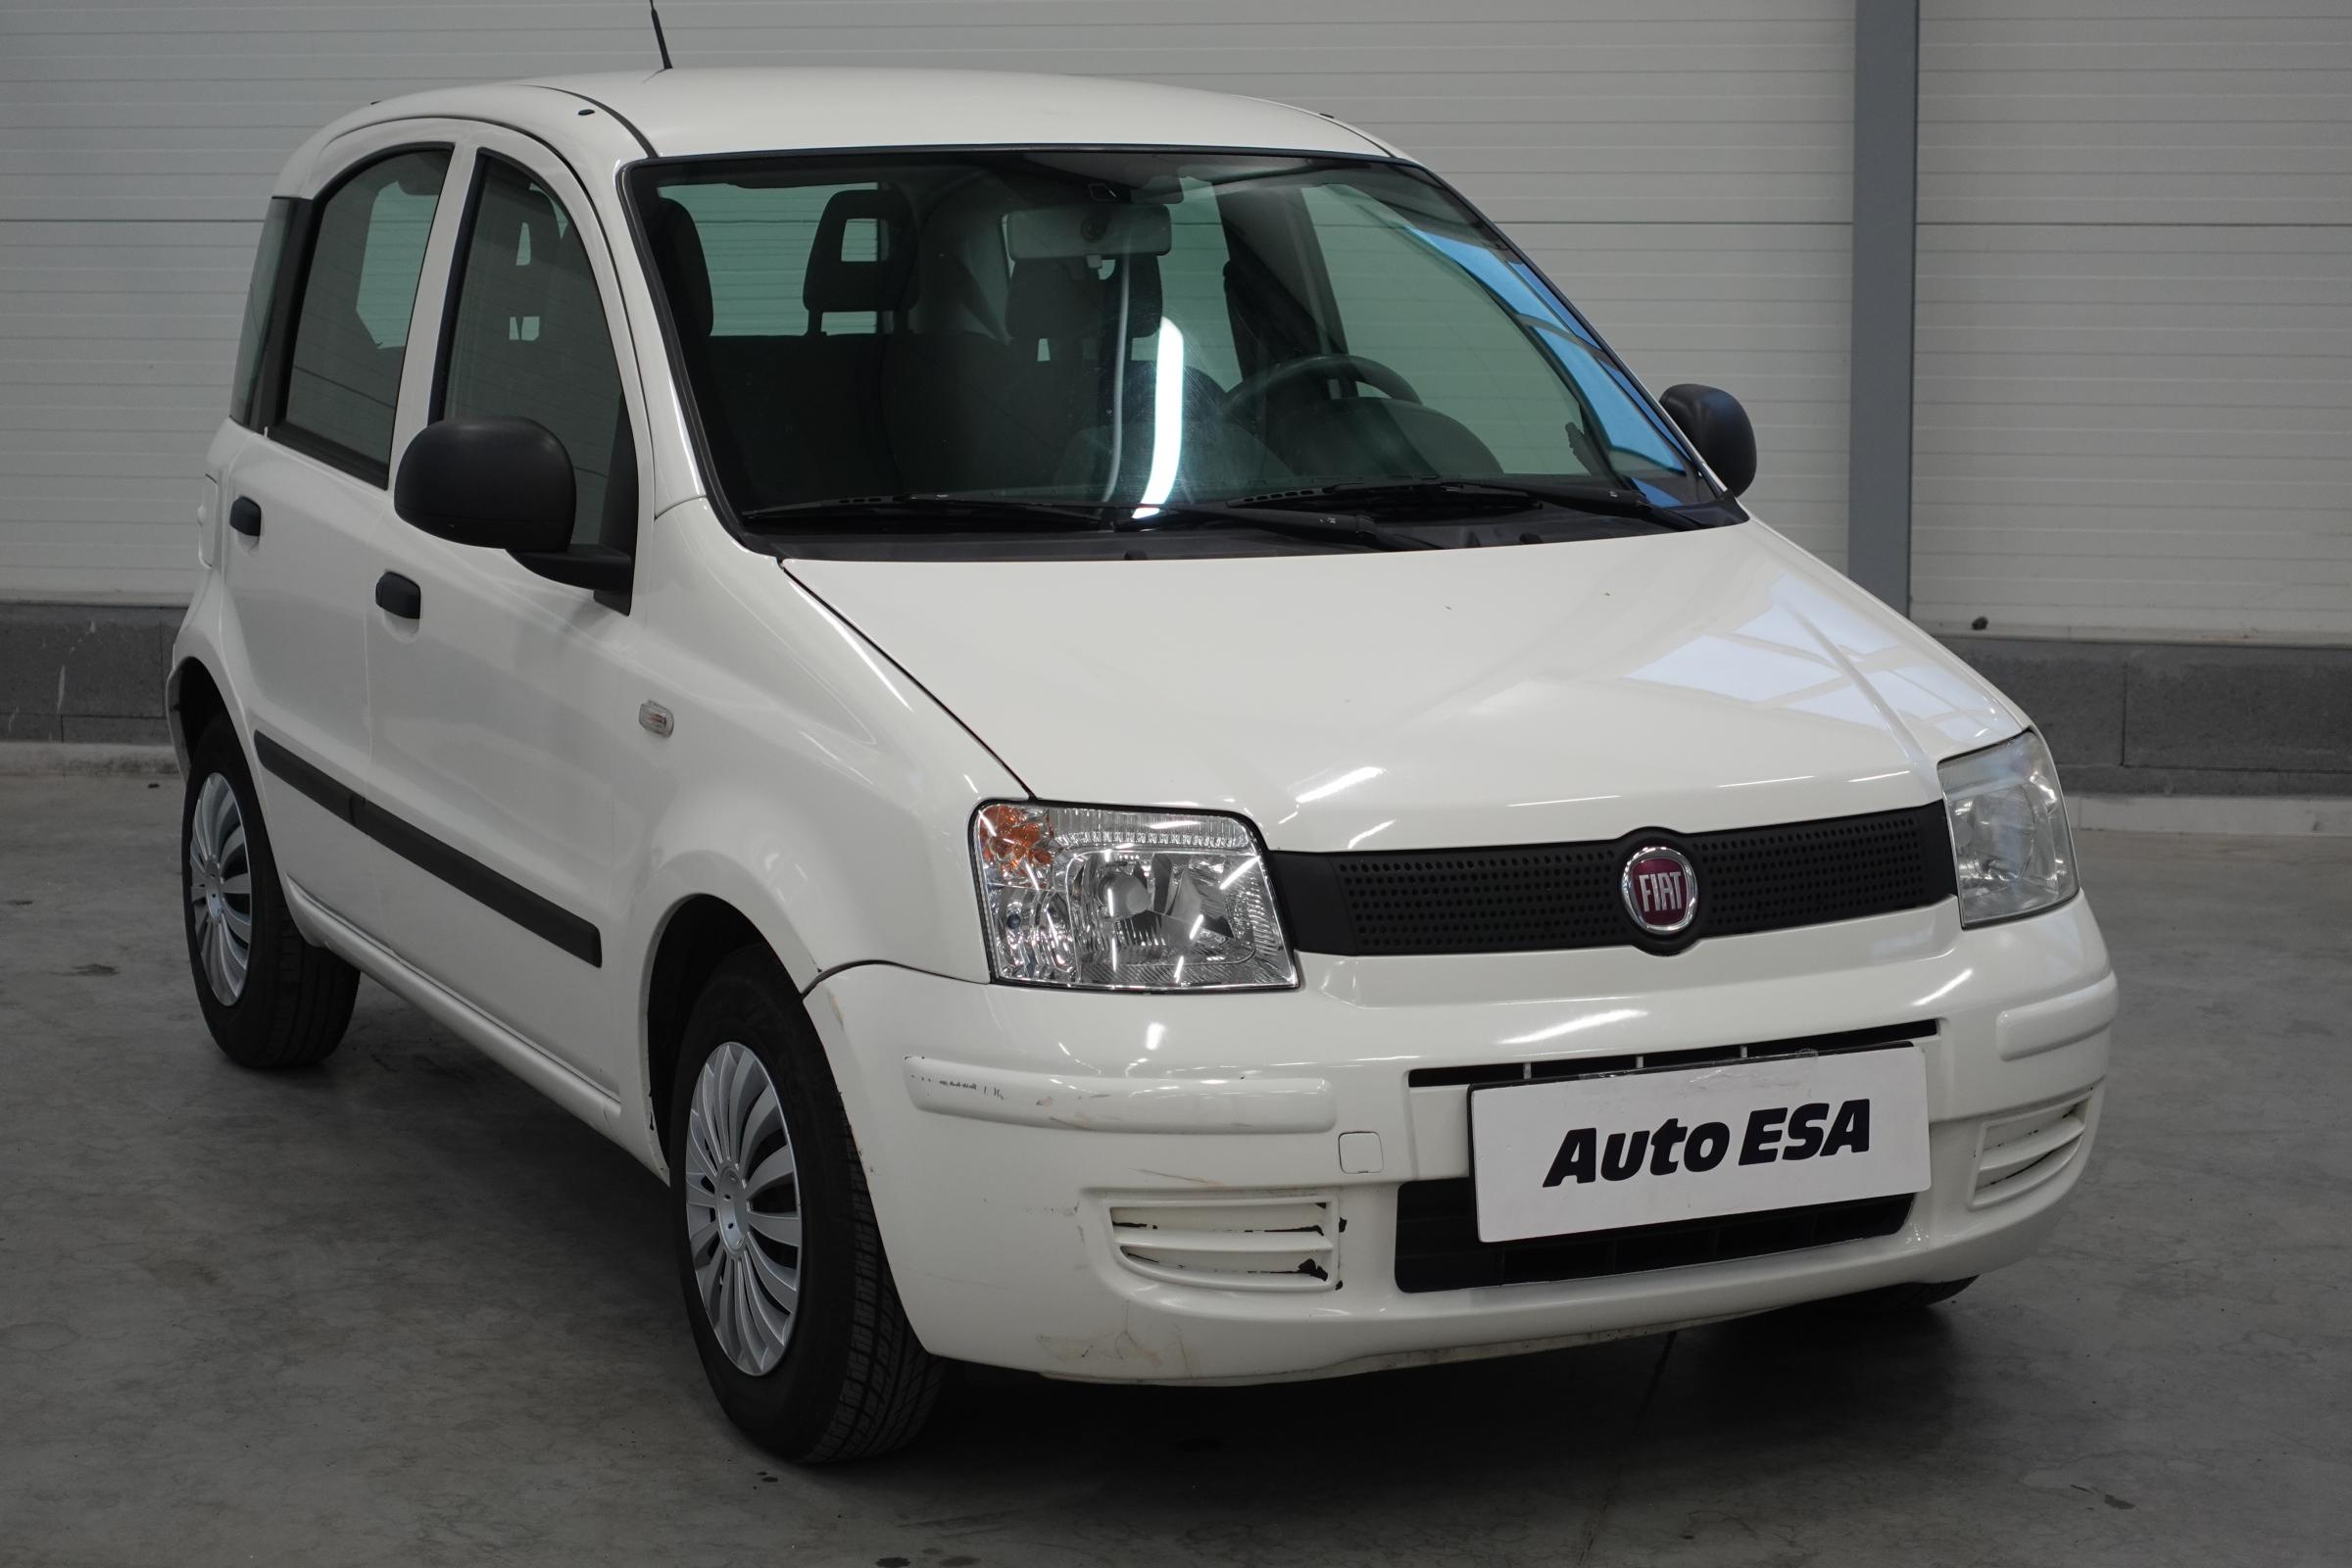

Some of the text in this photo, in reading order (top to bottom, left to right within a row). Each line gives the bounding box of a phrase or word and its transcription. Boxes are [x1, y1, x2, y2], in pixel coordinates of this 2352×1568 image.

[1639, 871, 1682, 912] FIAT
[1542, 1098, 1871, 1189] Auto ESA
